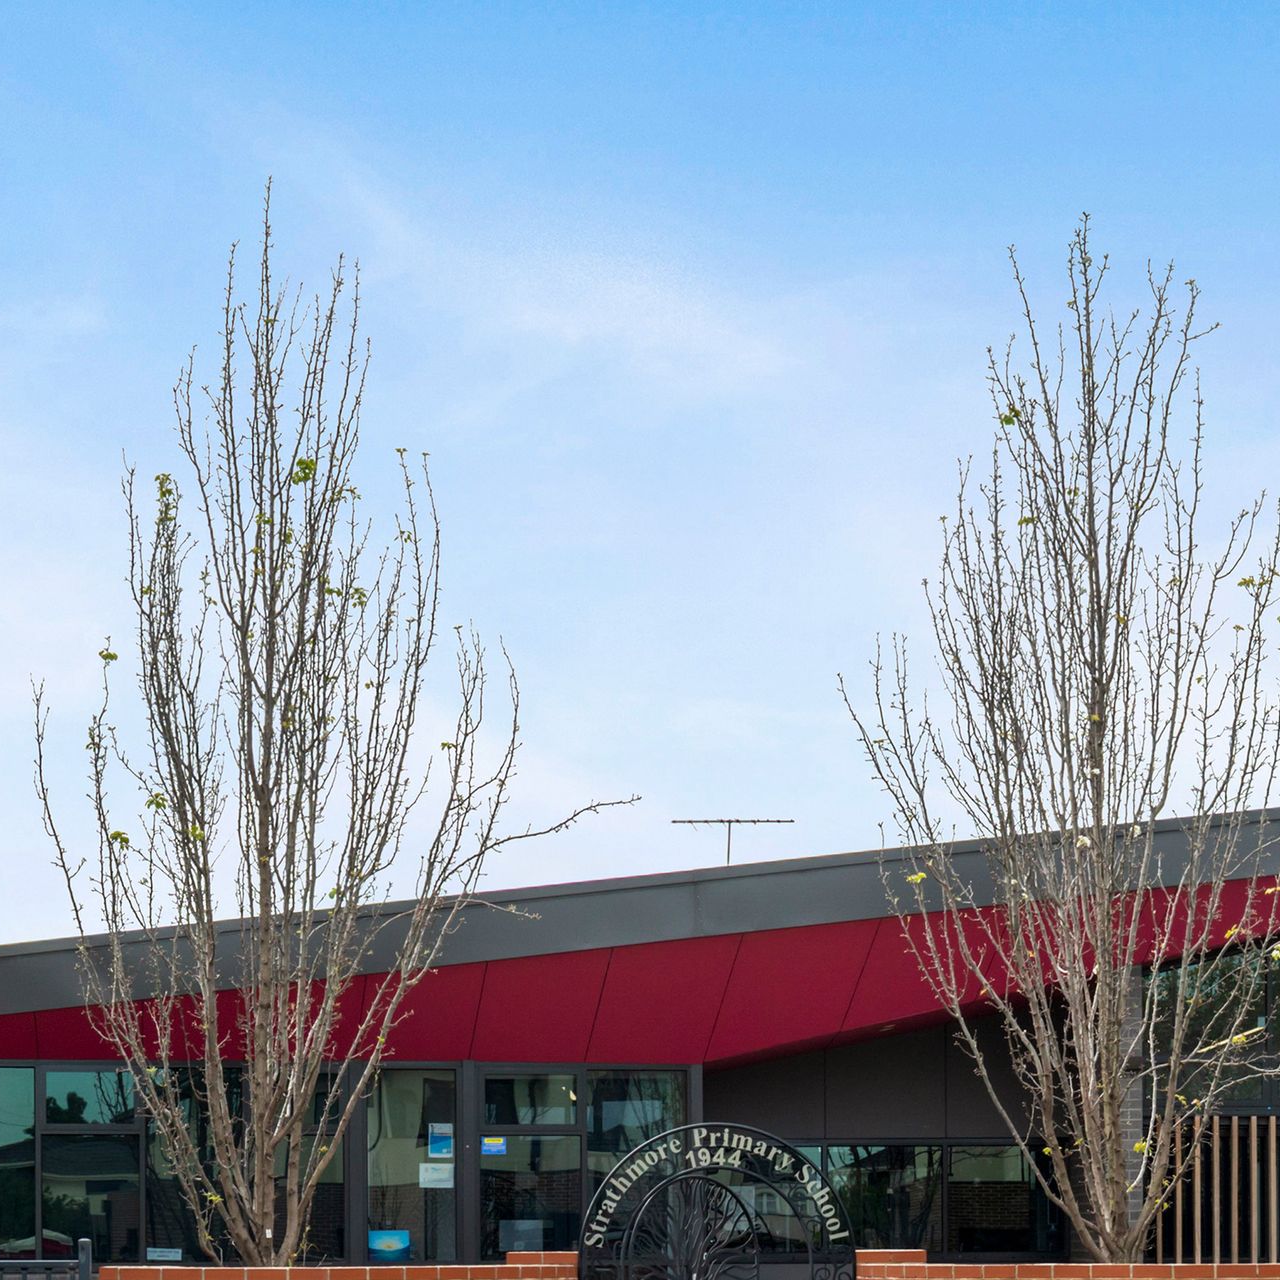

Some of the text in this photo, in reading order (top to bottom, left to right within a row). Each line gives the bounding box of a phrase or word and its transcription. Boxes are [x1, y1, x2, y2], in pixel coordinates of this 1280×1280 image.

[584, 1127, 849, 1248] Strathmore Primary School
[685, 1147, 742, 1168] 1944
